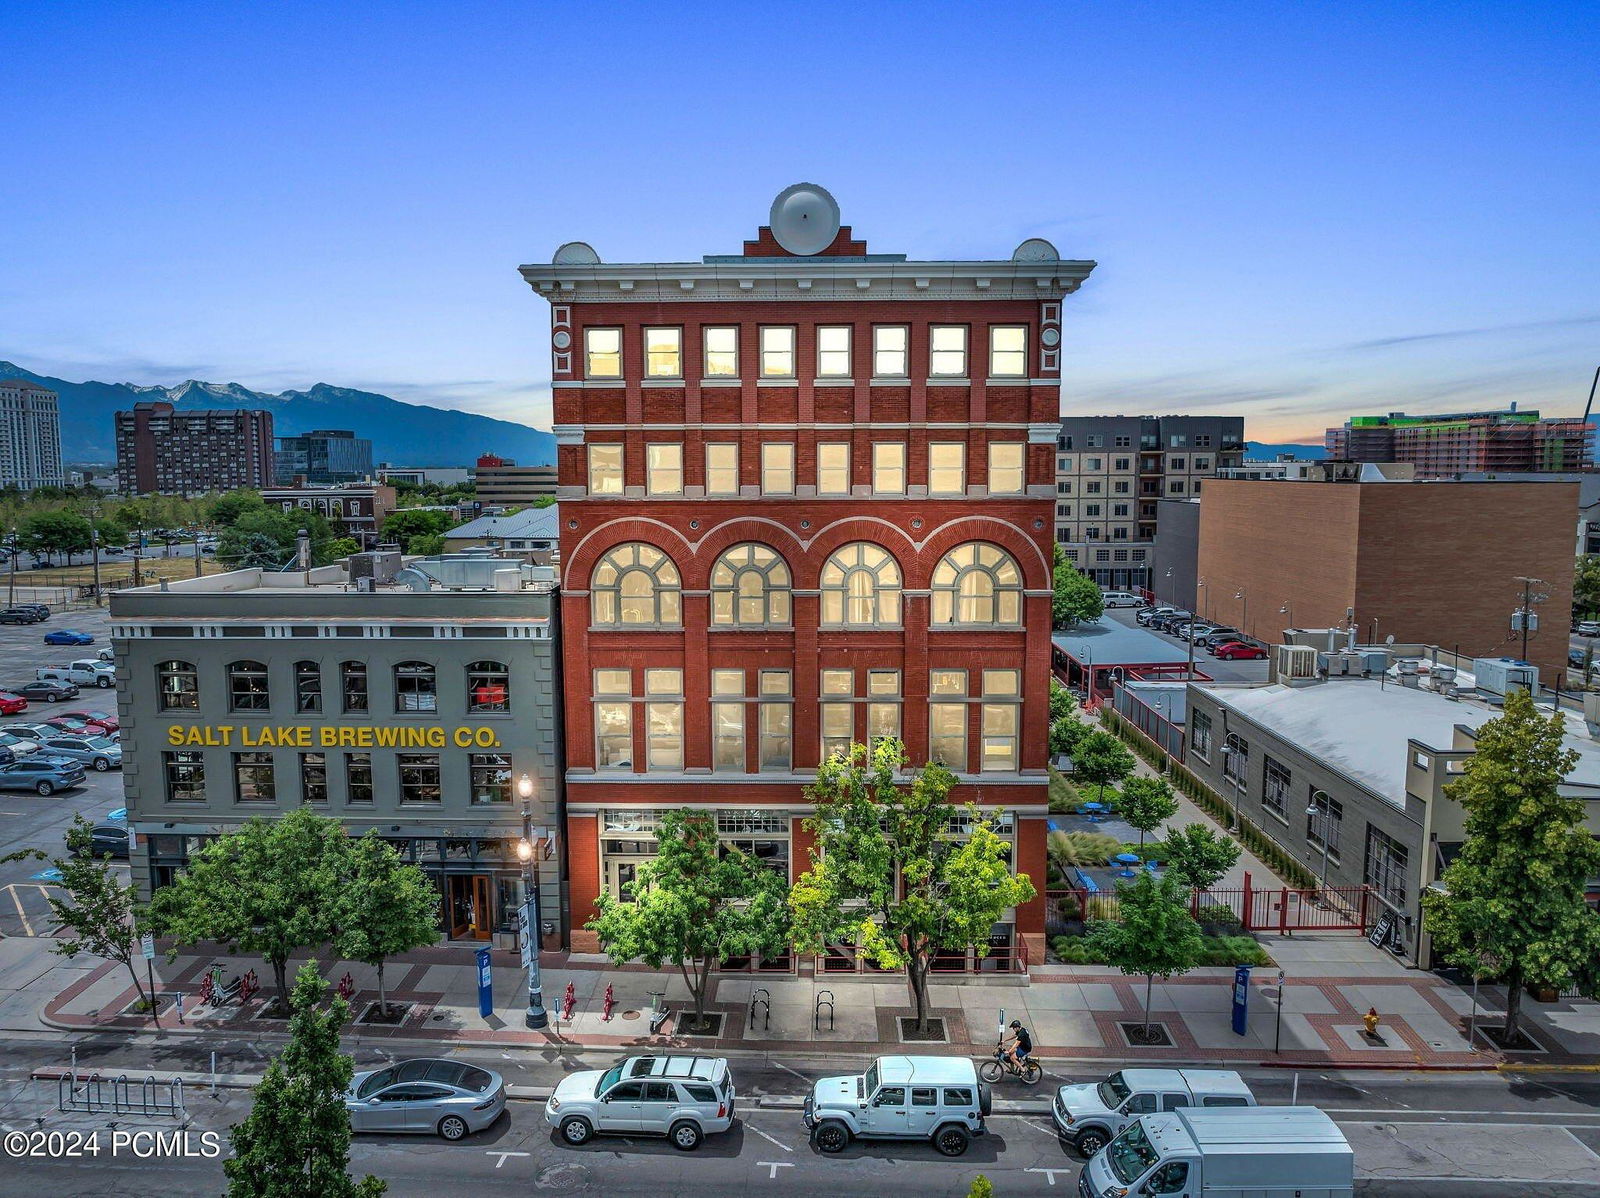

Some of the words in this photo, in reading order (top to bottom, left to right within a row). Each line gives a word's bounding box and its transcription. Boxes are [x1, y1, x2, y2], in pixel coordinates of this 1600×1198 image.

[168, 725, 234, 747] SALT
[242, 725, 313, 748] LAKE
[320, 726, 446, 748] BREWING
[454, 726, 502, 749] CO.
